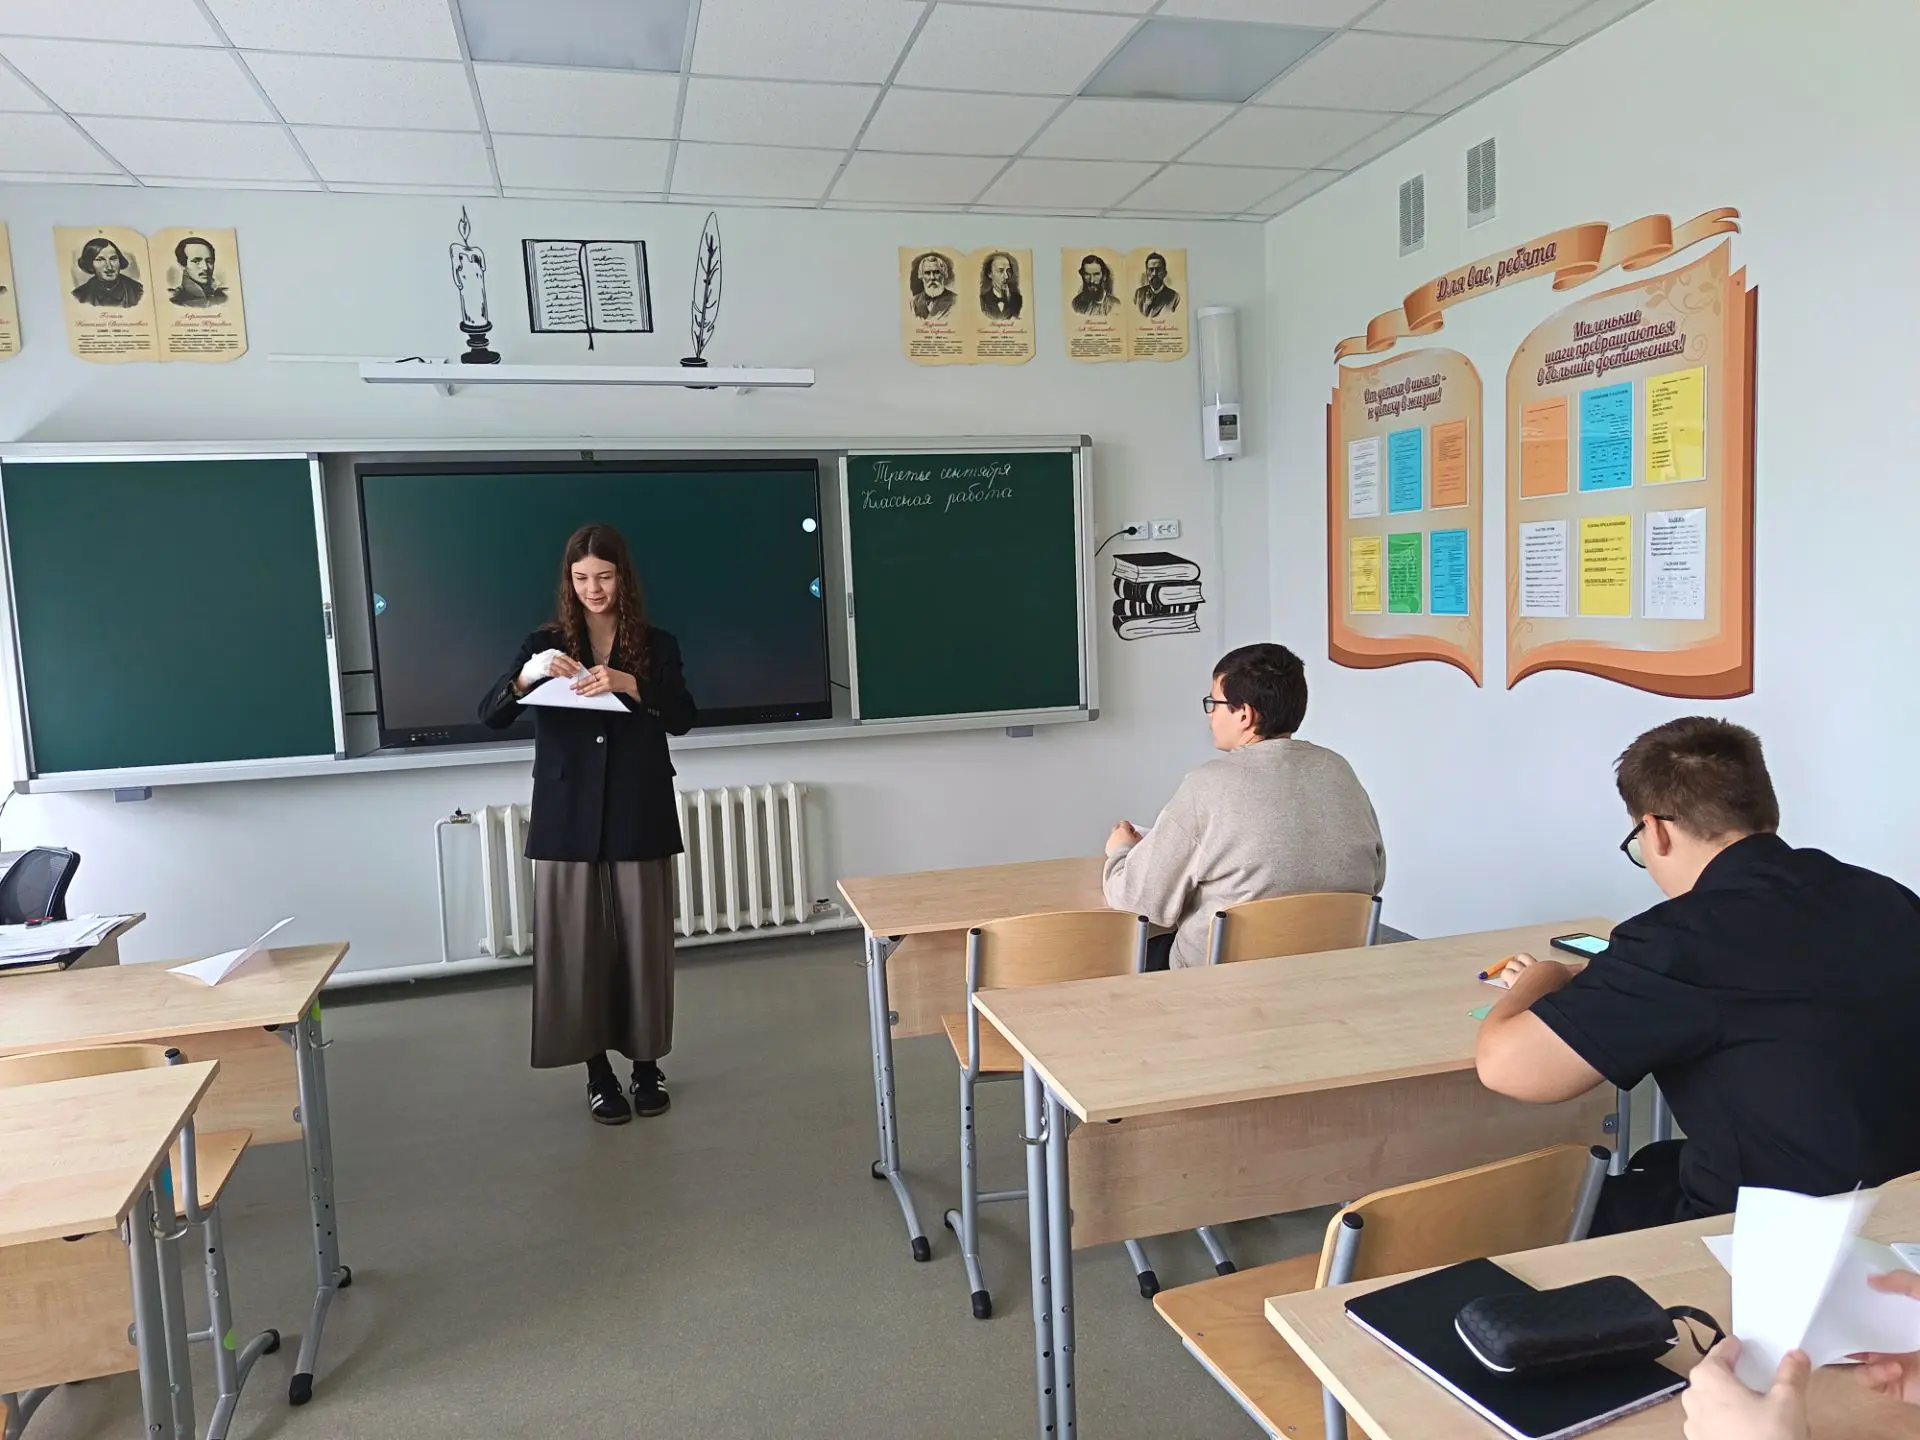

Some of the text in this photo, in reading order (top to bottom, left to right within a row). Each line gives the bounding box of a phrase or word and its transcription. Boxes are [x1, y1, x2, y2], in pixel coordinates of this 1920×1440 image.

[1436, 242, 1557, 302] Для вас, ребята
[1544, 320, 1676, 366] шаги превращаются
[1573, 310, 1642, 341] Маленькие
[1536, 333, 1687, 386] в большие достижения!
[873, 461, 1011, 491] Третье сентября
[861, 483, 1013, 513] Классная работа
